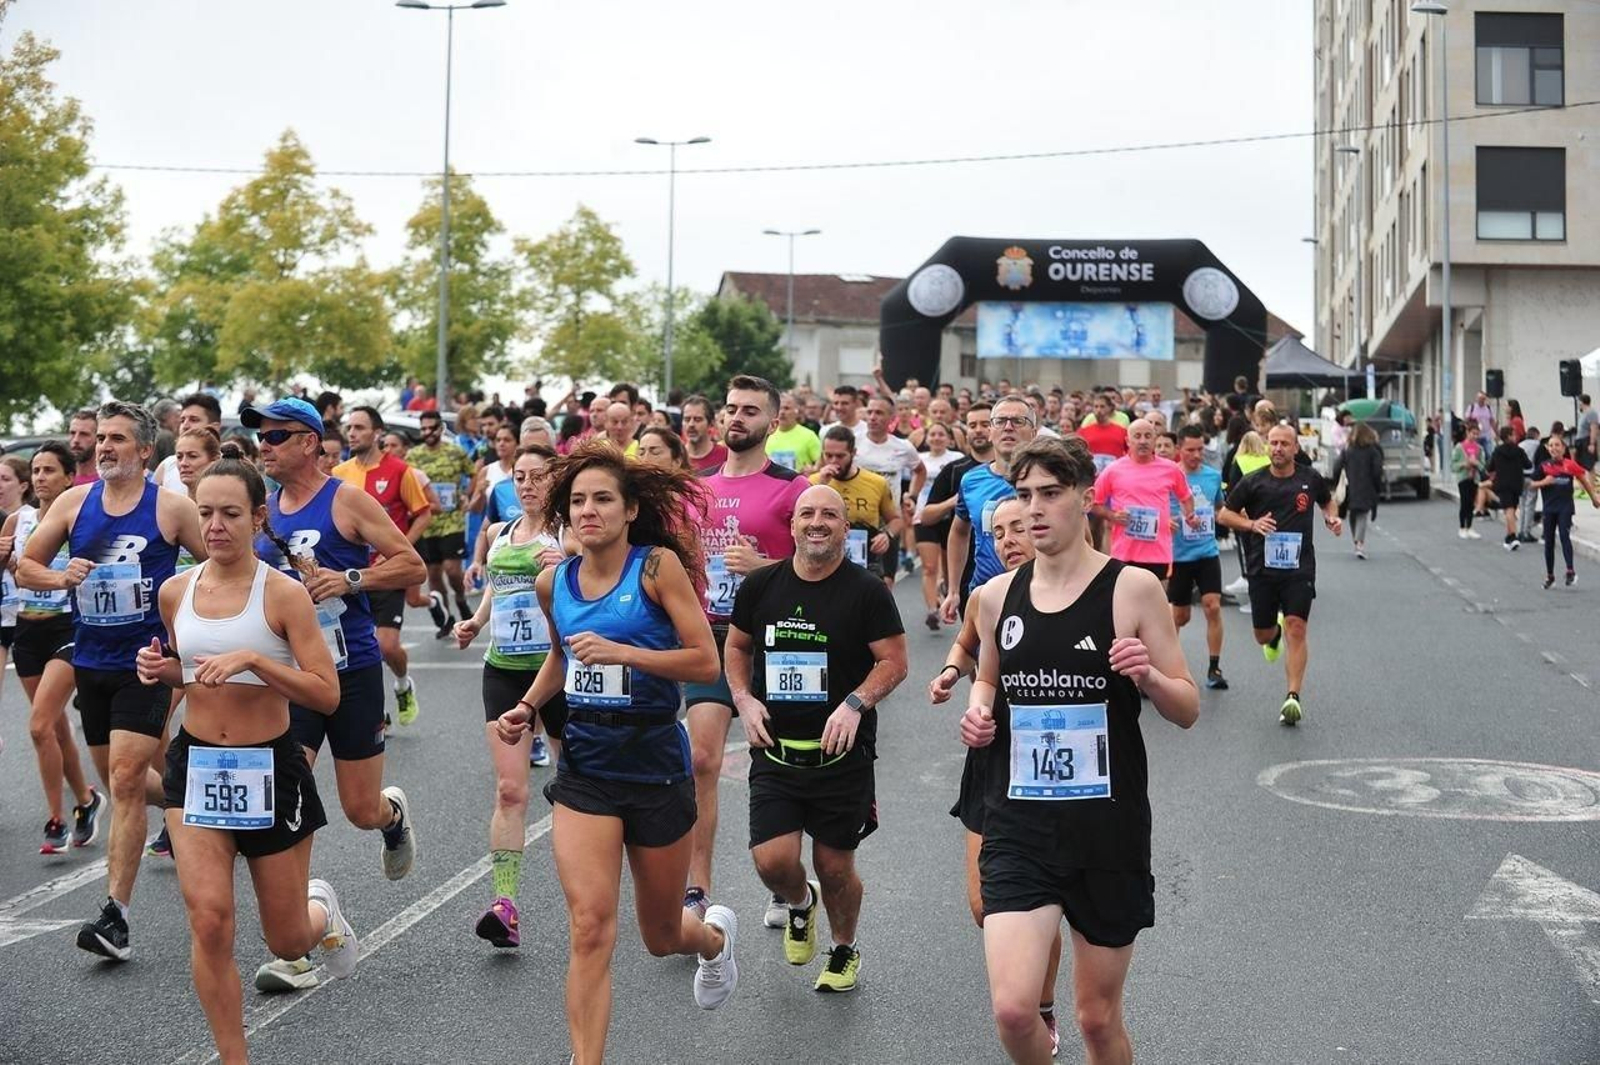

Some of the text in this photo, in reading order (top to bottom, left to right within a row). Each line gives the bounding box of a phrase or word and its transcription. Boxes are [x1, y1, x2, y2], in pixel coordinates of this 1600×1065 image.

[1048, 245, 1139, 260] Concello de
[1048, 262, 1154, 281] OURENSE
[94, 592, 117, 613] 171
[510, 619, 532, 641] 75
[574, 670, 604, 694] 829
[779, 673, 803, 691] 813
[1001, 668, 1107, 692] patoblanco
[1017, 689, 1085, 698] CELANOVA
[1031, 748, 1074, 781] 143
[204, 783, 248, 813] 593
